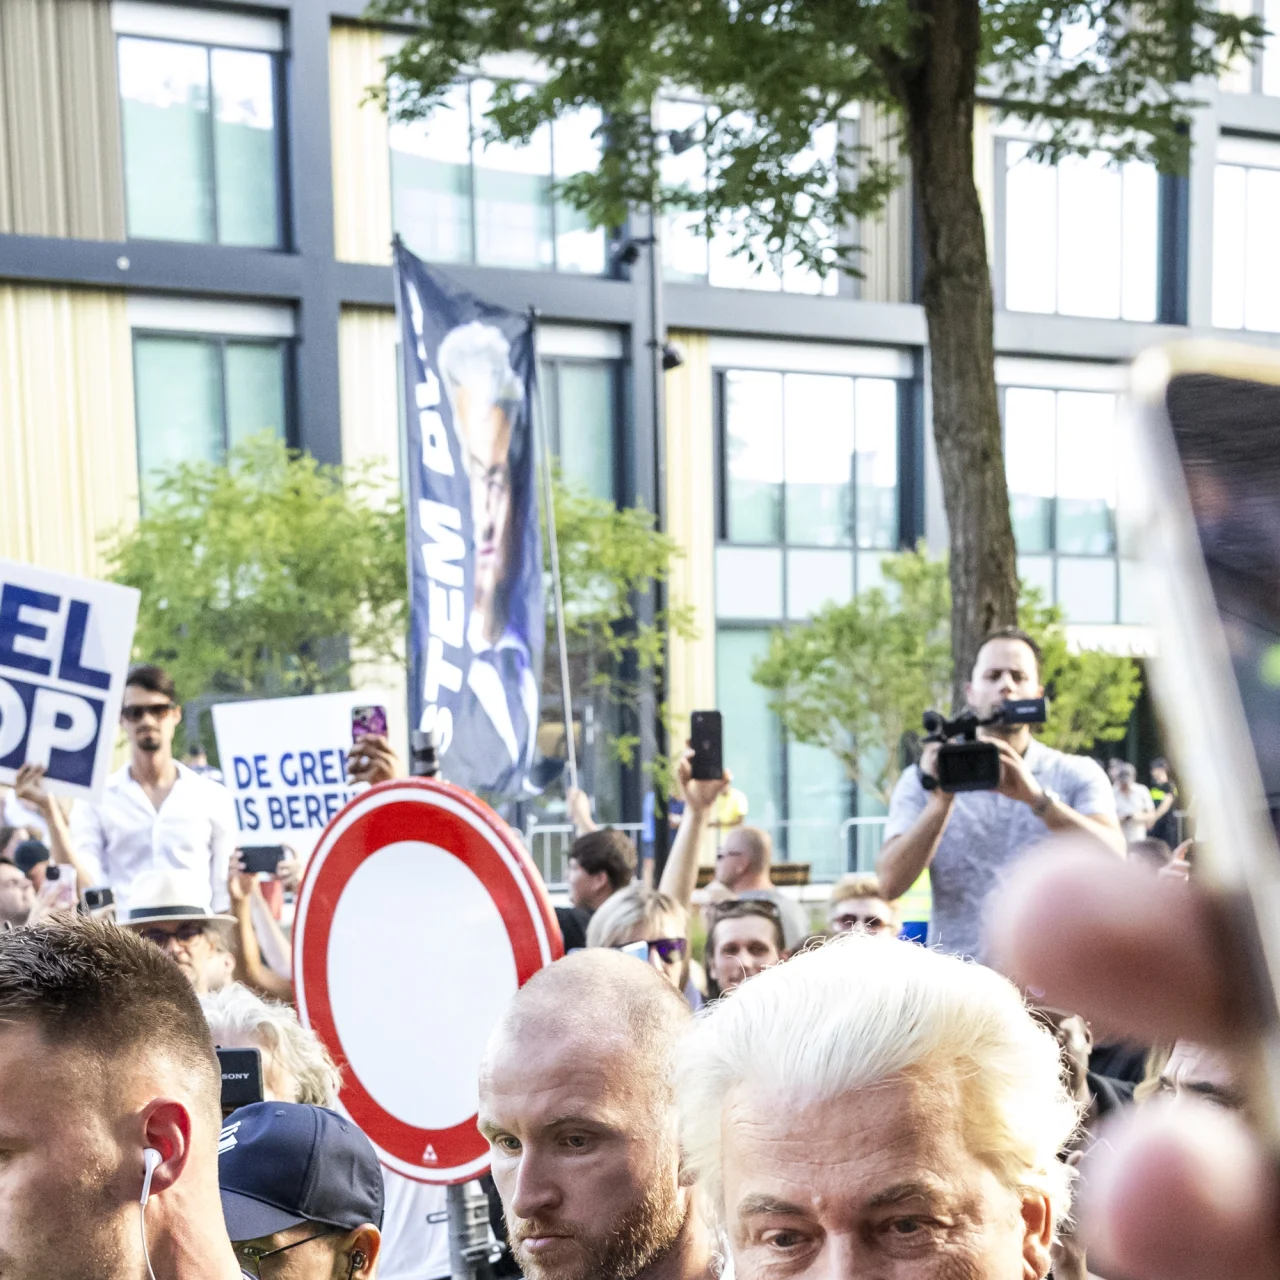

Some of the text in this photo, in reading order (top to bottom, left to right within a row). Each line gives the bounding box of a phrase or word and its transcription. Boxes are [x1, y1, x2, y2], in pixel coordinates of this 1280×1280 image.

[418, 498, 466, 755] STEM
[233, 754, 271, 789] DE
[235, 792, 357, 831] IS BERE
[222, 1072, 250, 1080] SONY
